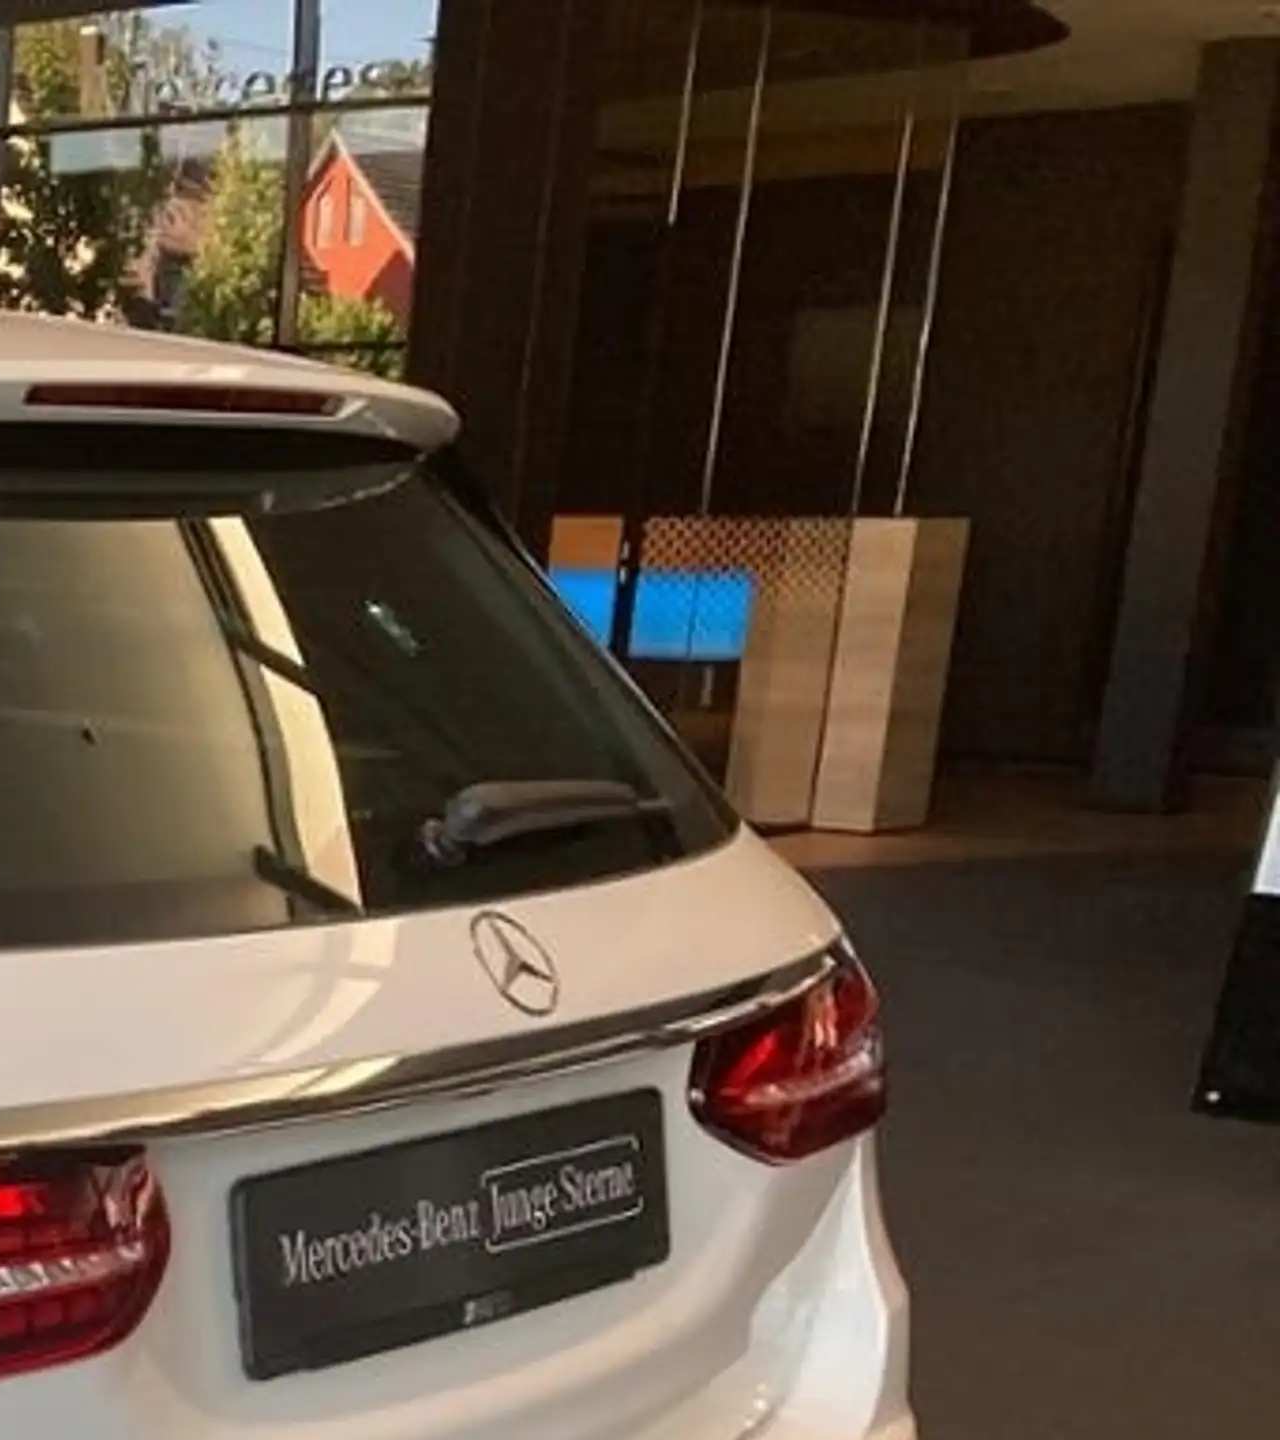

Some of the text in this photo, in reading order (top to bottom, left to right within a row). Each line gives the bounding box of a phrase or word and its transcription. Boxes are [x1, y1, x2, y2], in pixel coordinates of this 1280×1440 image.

[278, 1161, 635, 1287] Mercedes-Benz Junge Sterne
